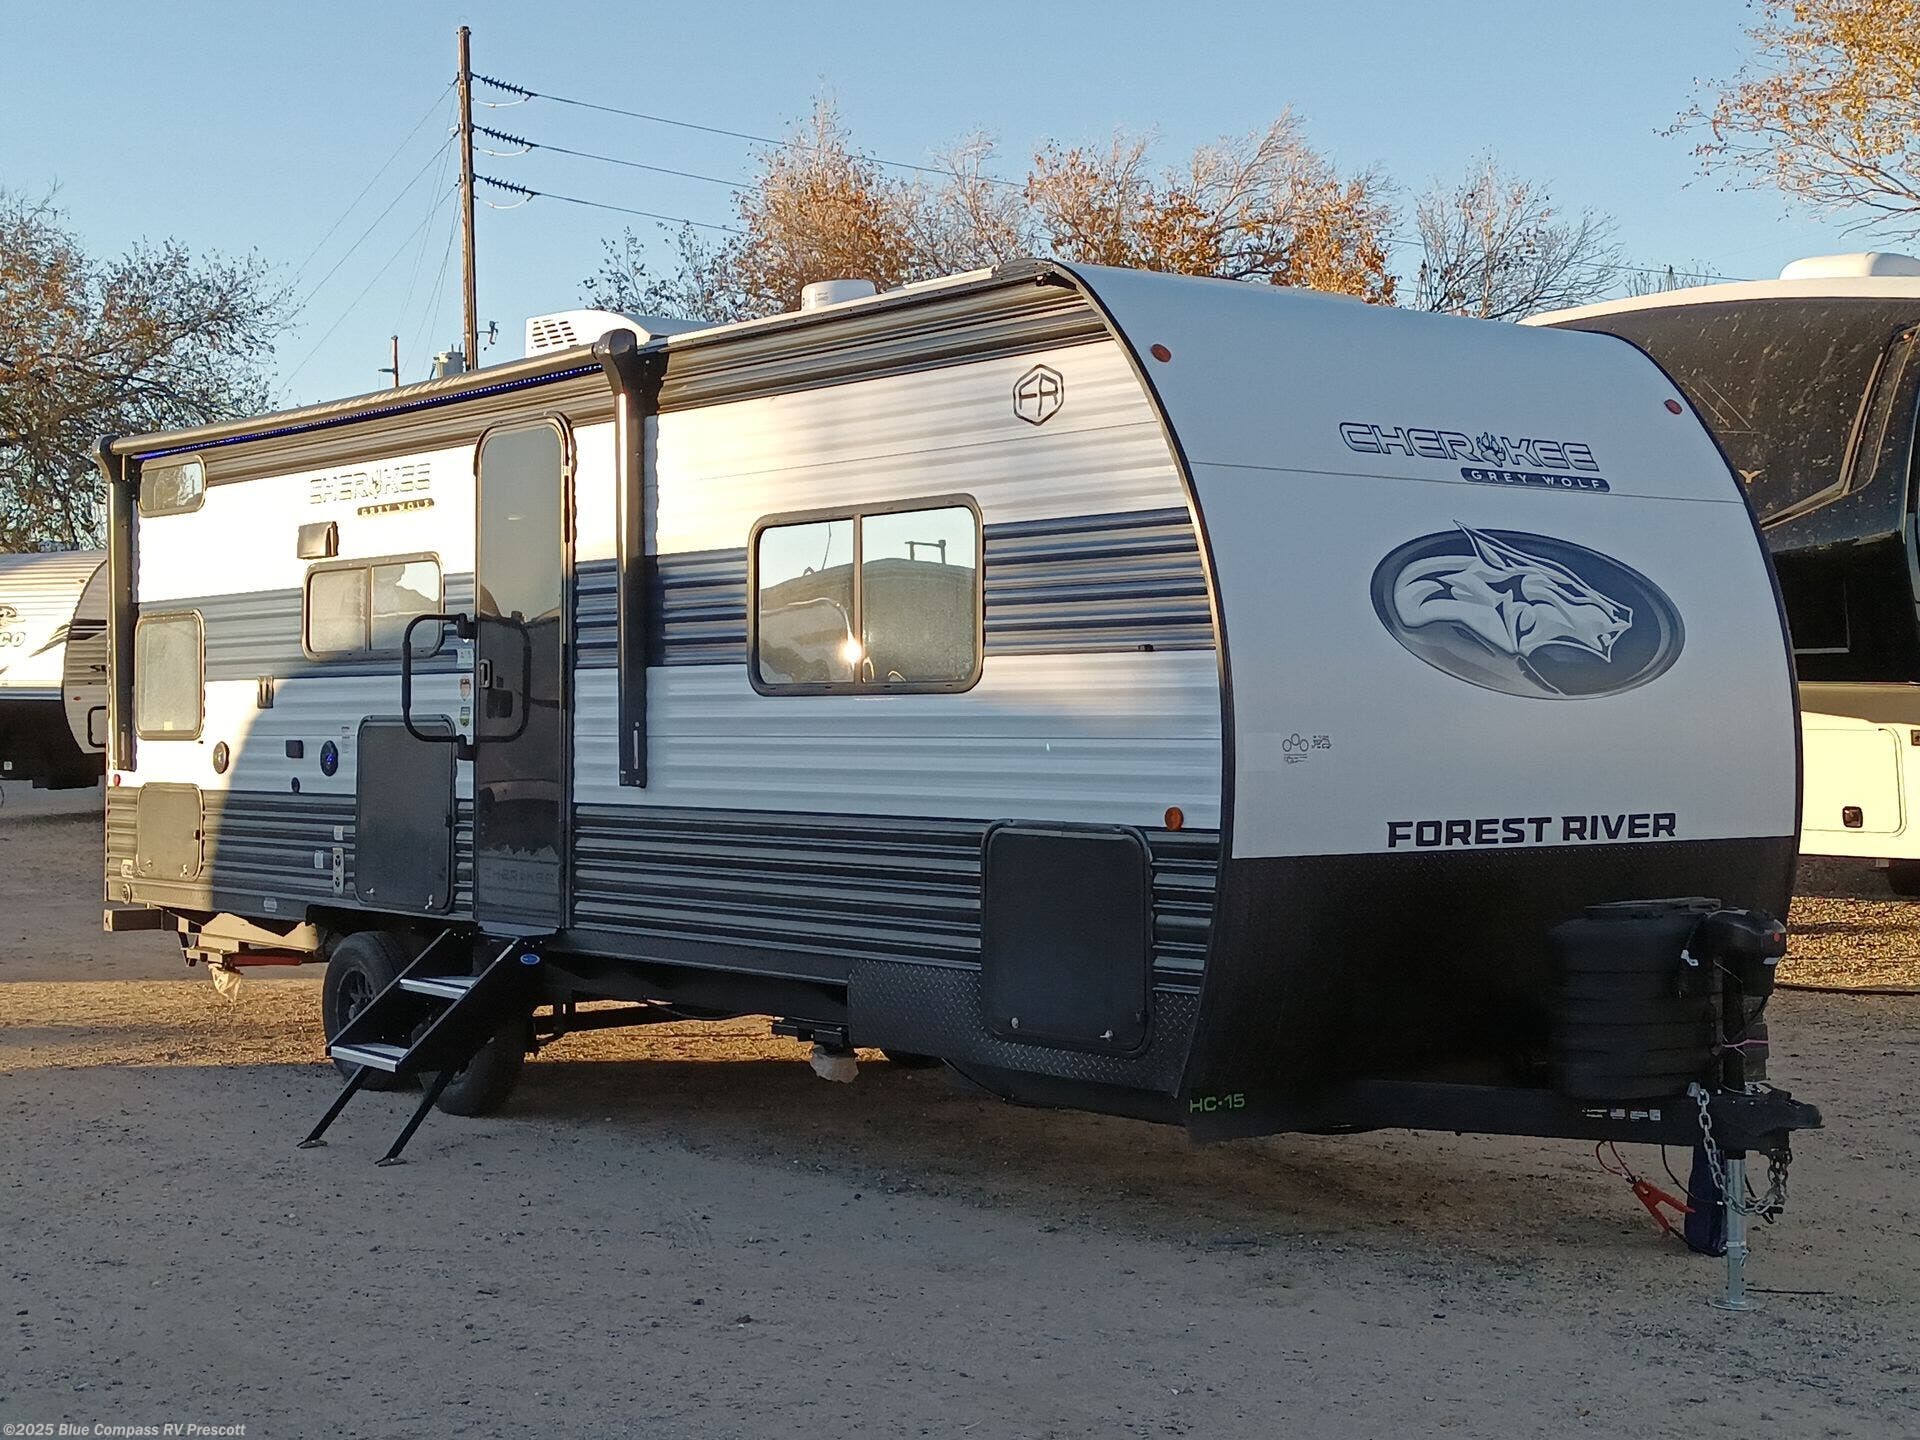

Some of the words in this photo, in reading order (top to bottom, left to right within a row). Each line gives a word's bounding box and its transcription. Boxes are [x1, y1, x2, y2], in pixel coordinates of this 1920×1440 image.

[1339, 422, 1600, 472] CHEROKEE
[1470, 469, 1529, 485] GREY
[1541, 475, 1601, 490] WOLF
[1386, 816, 1553, 848] FOREST
[1560, 812, 1677, 841] RIVER
